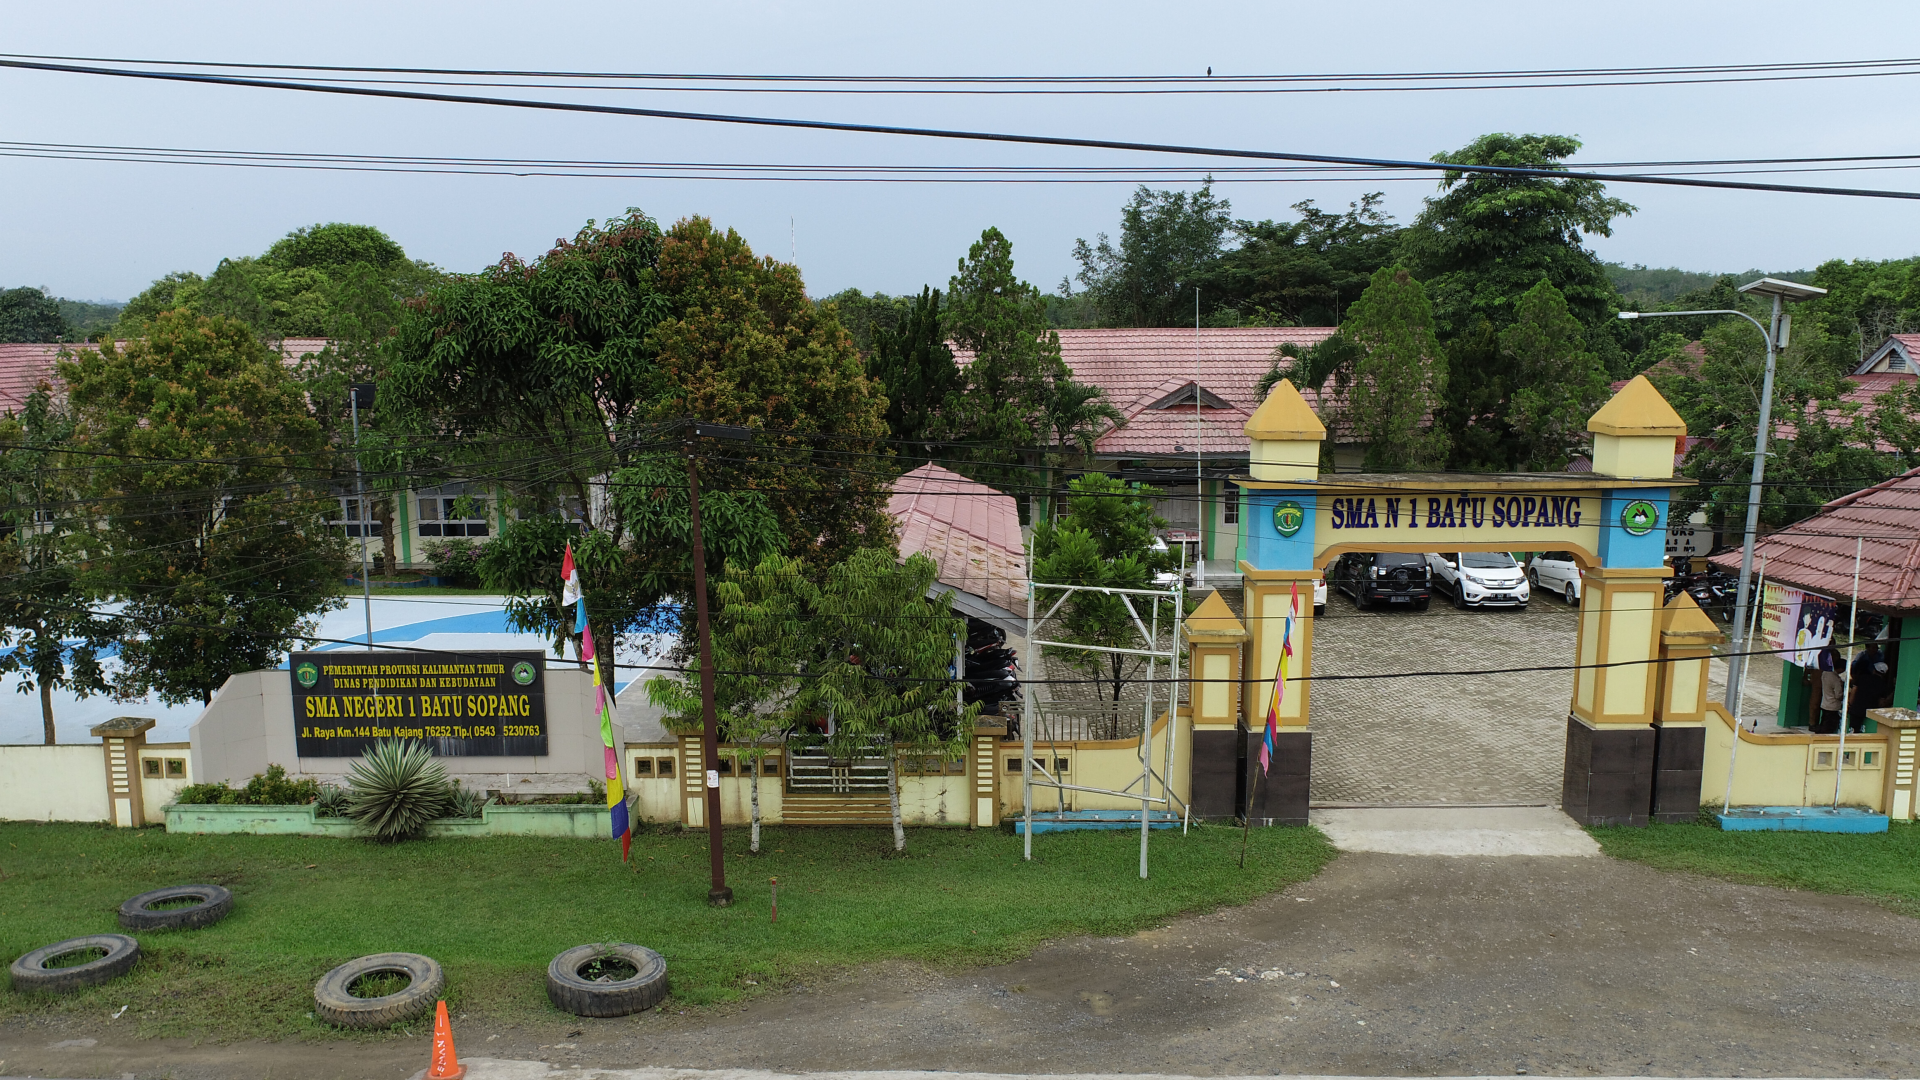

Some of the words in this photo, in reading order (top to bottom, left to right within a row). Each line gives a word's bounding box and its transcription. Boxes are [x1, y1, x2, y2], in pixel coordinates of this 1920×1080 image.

[1331, 497, 1379, 530] SMA
[1384, 497, 1401, 528] N
[1408, 497, 1418, 528] 1
[1426, 497, 1487, 529] BATU
[1492, 496, 1582, 528] SOPANG
[1762, 612, 1781, 622] SOPANG
[323, 665, 379, 675] PEMERINTAH
[380, 664, 420, 675] PROVINSI
[422, 664, 476, 675] KALIMANTAN
[477, 664, 505, 674] TIMUR
[333, 678, 361, 689] DINAS
[363, 678, 418, 688] PENDIDIKAN
[420, 677, 437, 688] DAN
[439, 677, 496, 688] KEBUDAYAAN
[305, 695, 340, 718] SMA
[342, 695, 404, 718] NEGERI
[408, 696, 416, 717] 1
[420, 695, 462, 717] BATU
[467, 695, 530, 717] SOPANG
[301, 727, 312, 738] Jl.
[314, 727, 335, 740] Raya
[337, 726, 370, 737] Km.144
[372, 726, 392, 737] Batu
[394, 726, 423, 740] Kajang
[425, 726, 451, 737] 76252
[474, 726, 496, 737] 0543
[503, 725, 540, 737] 5230763
